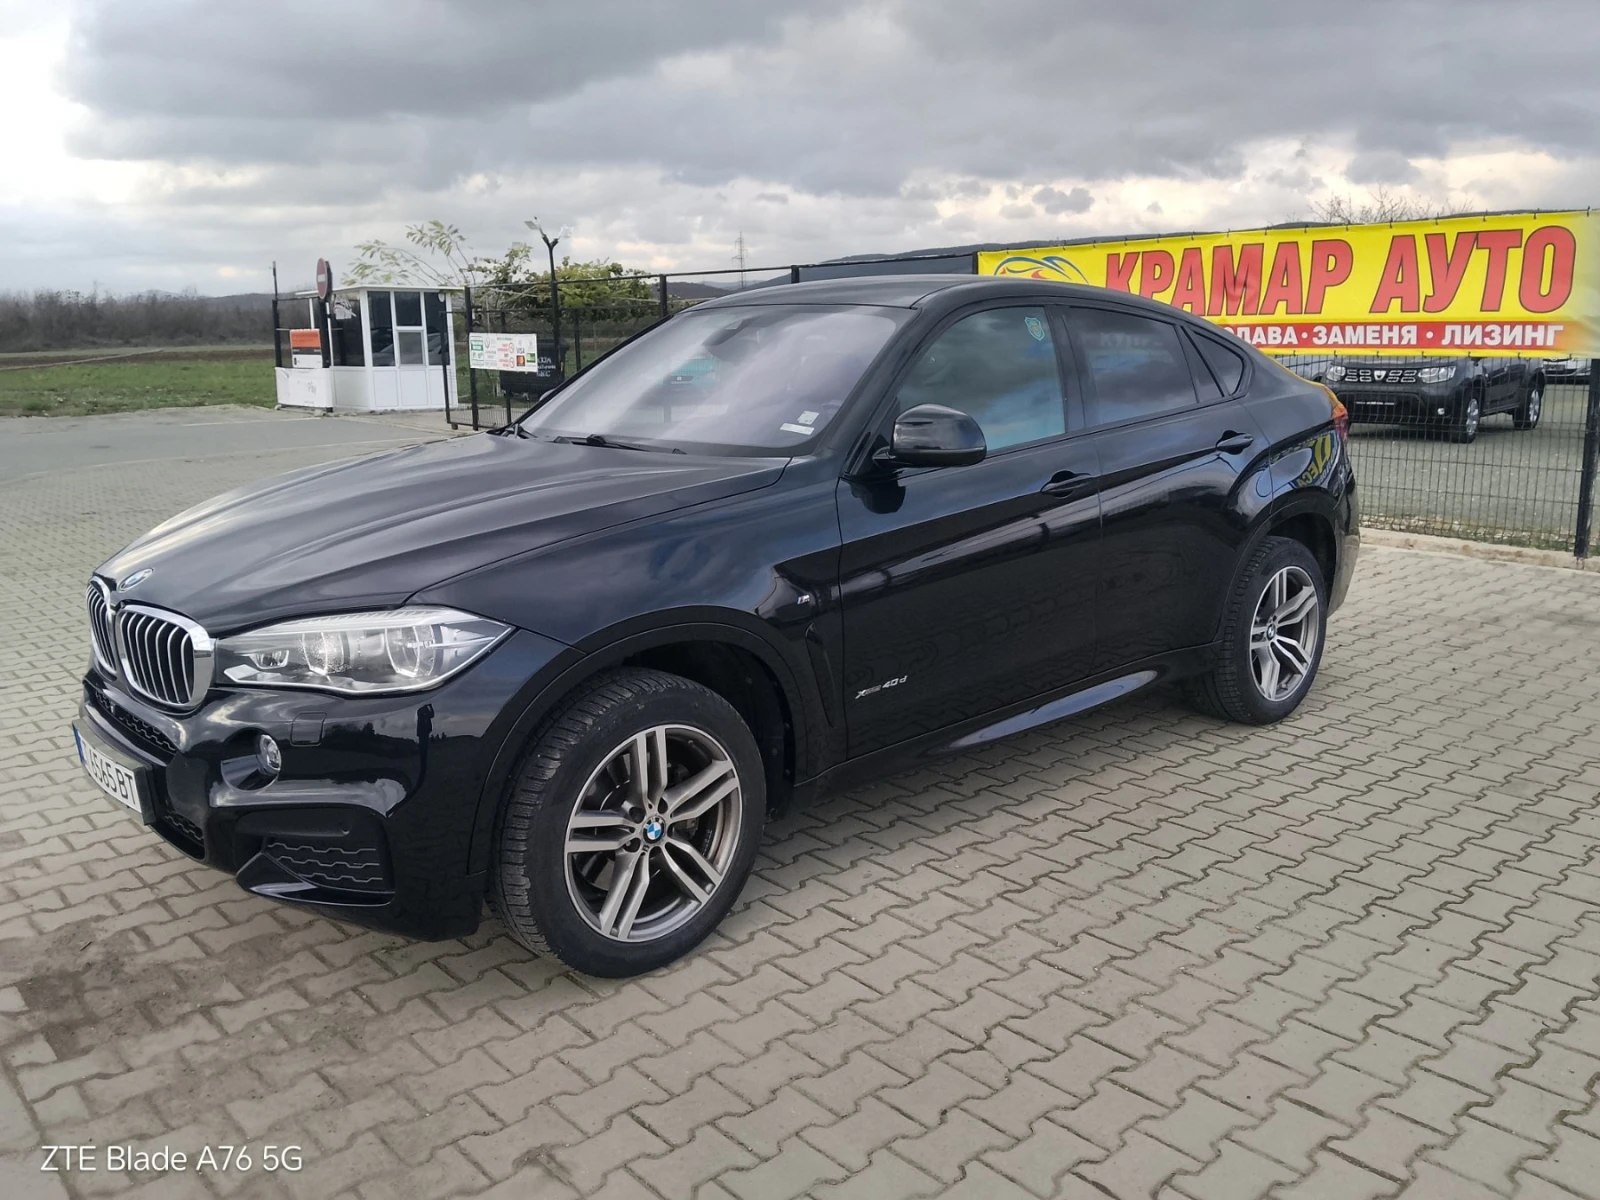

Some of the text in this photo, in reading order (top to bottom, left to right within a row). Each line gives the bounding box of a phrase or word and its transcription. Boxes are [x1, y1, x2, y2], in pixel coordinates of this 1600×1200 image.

[1105, 225, 1576, 316] КРАМАР АУТО
[1312, 324, 1417, 346] ЗАМЕНЯ
[1441, 323, 1563, 346] ЛИЗИНГ
